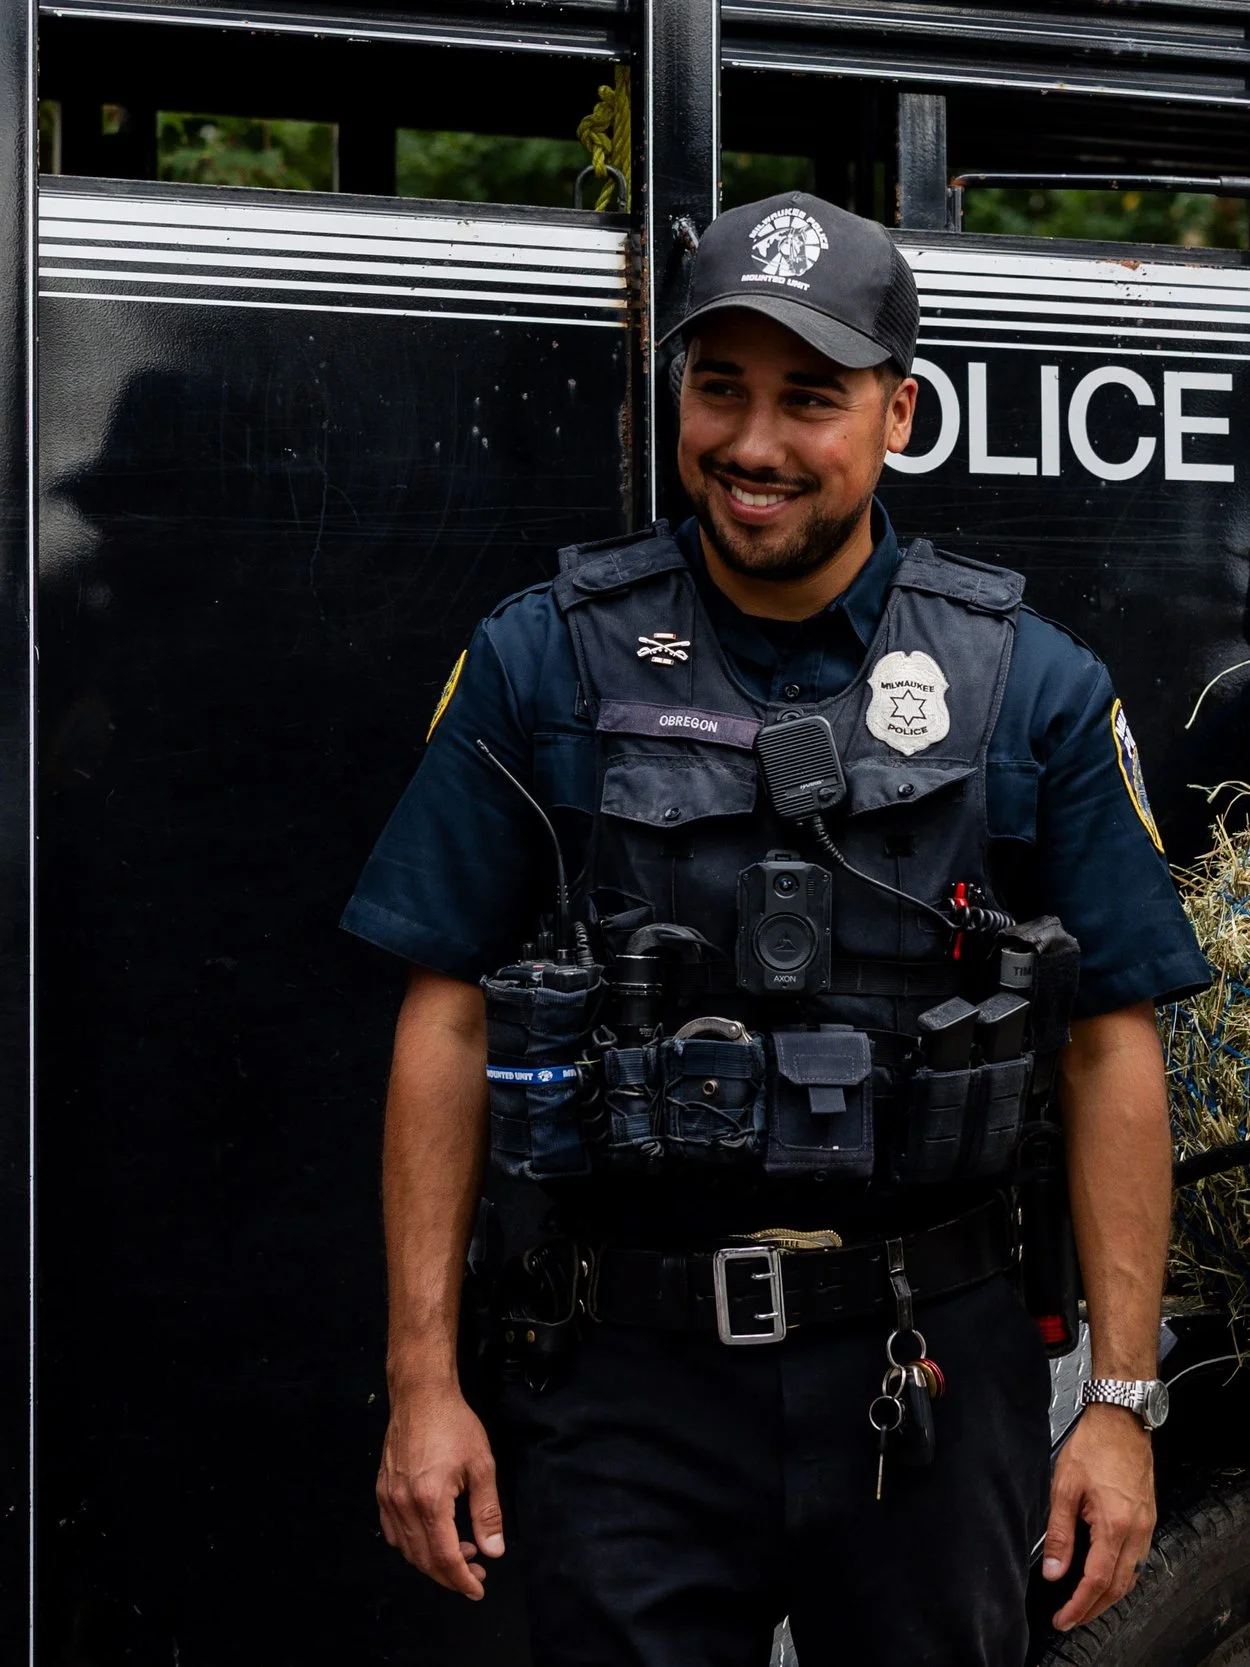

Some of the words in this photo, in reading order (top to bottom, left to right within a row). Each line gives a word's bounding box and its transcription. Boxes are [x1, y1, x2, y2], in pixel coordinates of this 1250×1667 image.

[749, 208, 806, 238] MILWAUKEE
[806, 216, 829, 249] POLICE
[741, 274, 786, 284] MOUNTED
[786, 279, 811, 291] UNIT
[884, 357, 1235, 482] OLICE
[881, 680, 935, 692] MILWAUKEE
[659, 715, 718, 733] OBREGON
[888, 724, 928, 735] POLICE
[515, 1071, 533, 1081] UNIT
